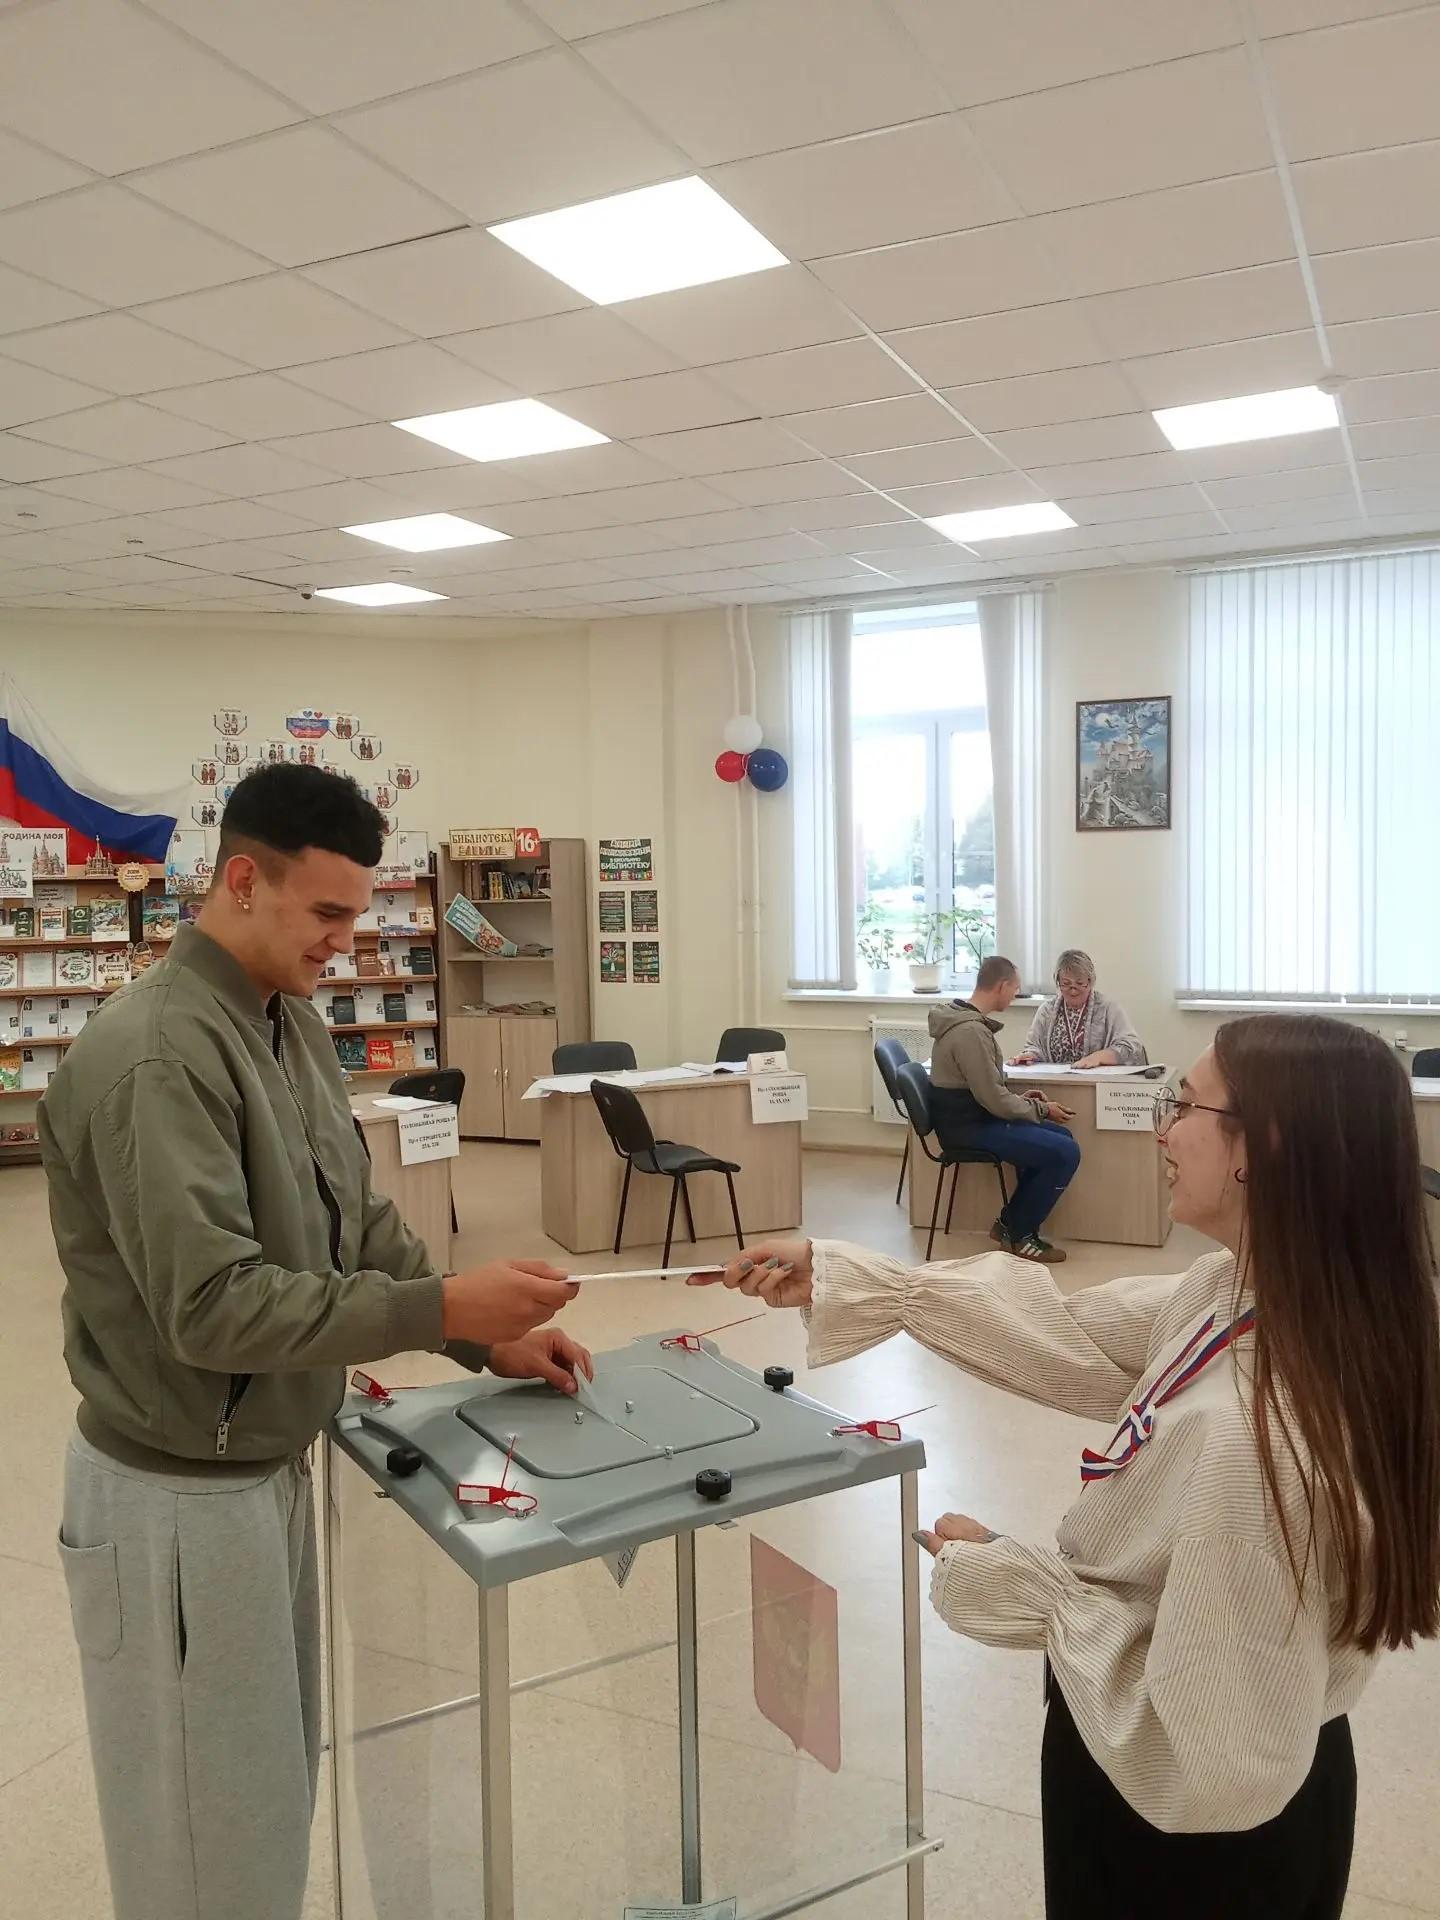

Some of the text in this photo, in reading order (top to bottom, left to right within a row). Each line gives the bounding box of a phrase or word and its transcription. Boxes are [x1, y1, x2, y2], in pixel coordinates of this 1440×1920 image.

[452, 833, 513, 843] БИБЛИОТЕКА
[517, 832, 540, 852] 16+
[601, 862, 651, 870] БИБЛИОТЕКУ
